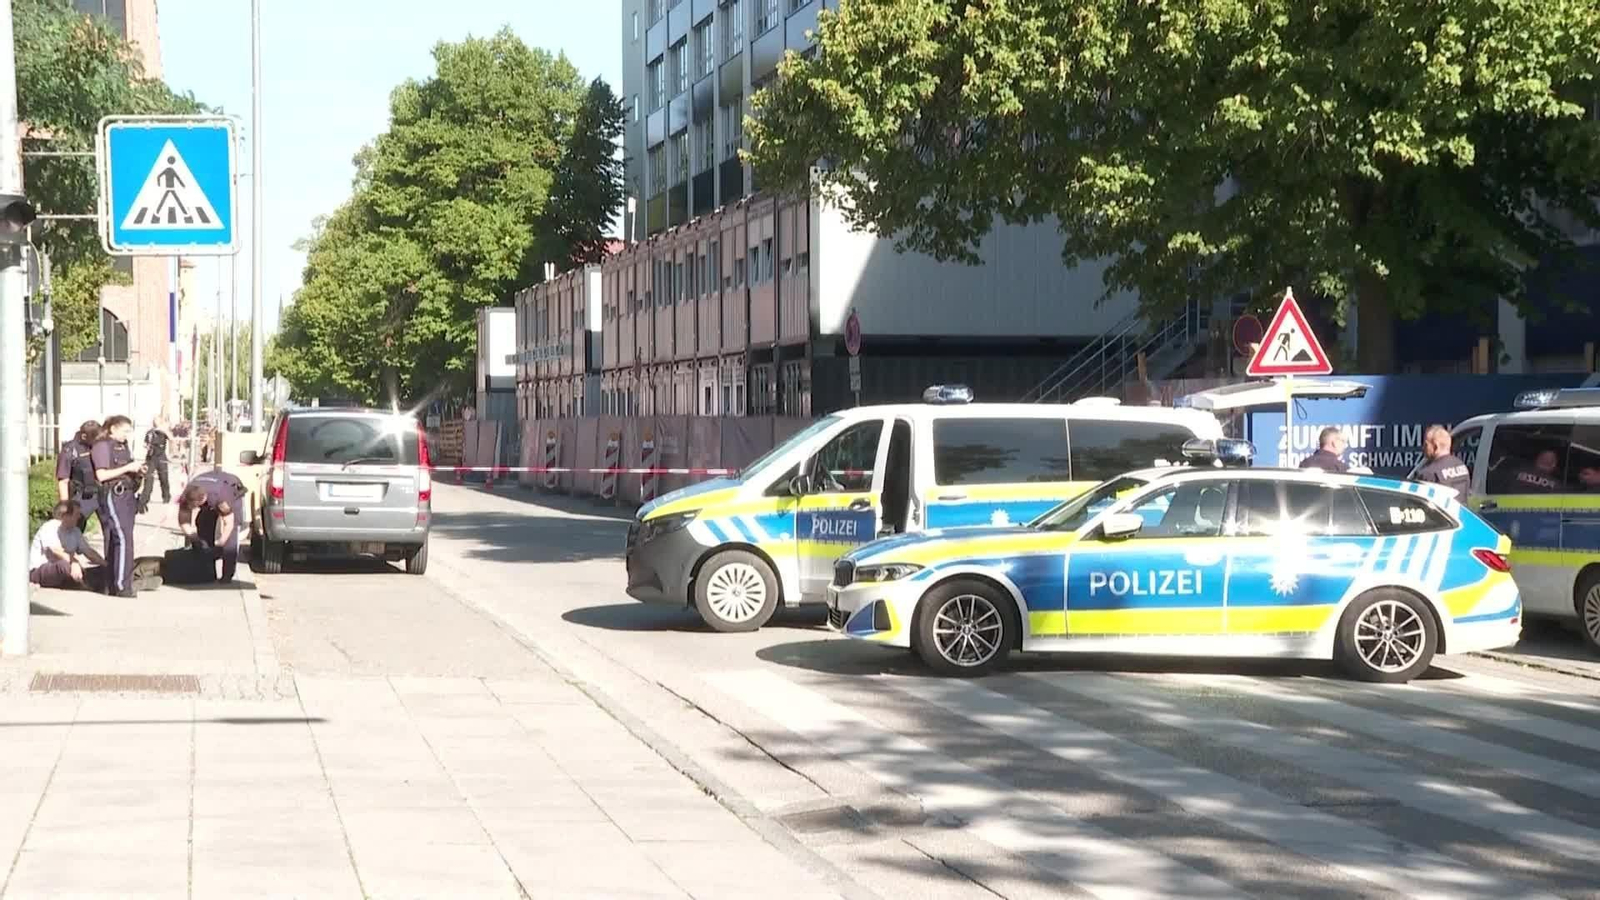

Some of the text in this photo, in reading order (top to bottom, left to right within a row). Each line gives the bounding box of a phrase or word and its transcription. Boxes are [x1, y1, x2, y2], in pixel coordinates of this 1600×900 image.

[1278, 425, 1386, 450] ZUKNFT
[1393, 424, 1422, 447] IM
[812, 518, 857, 536] POLIZEI
[1090, 569, 1203, 597] POLIZEI
